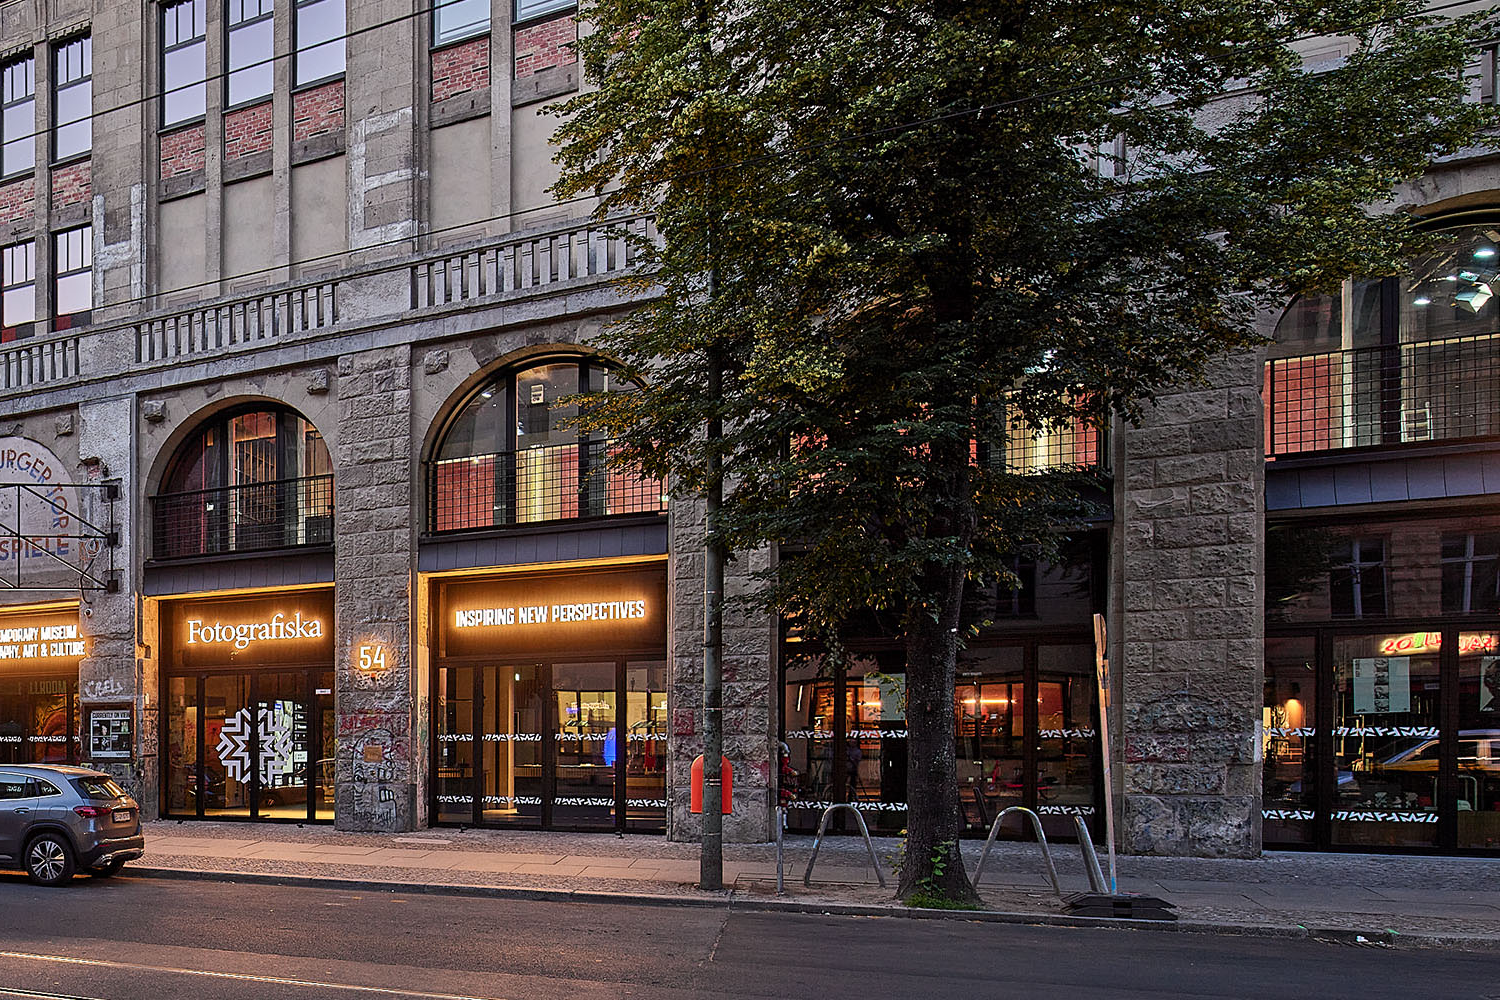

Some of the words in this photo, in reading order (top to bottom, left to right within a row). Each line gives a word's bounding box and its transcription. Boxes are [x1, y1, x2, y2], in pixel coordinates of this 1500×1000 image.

[45, 482, 69, 529] TOR
[455, 608, 515, 628] INSPIRING
[518, 606, 549, 624] NEW
[551, 600, 646, 623] PERSPECTIVES
[40, 625, 77, 640] MUSEUM
[187, 612, 323, 650] Fotografiska
[22, 644, 39, 658] ART
[40, 644, 48, 657] &
[50, 641, 86, 657] CULTURE
[359, 646, 386, 669] 54
